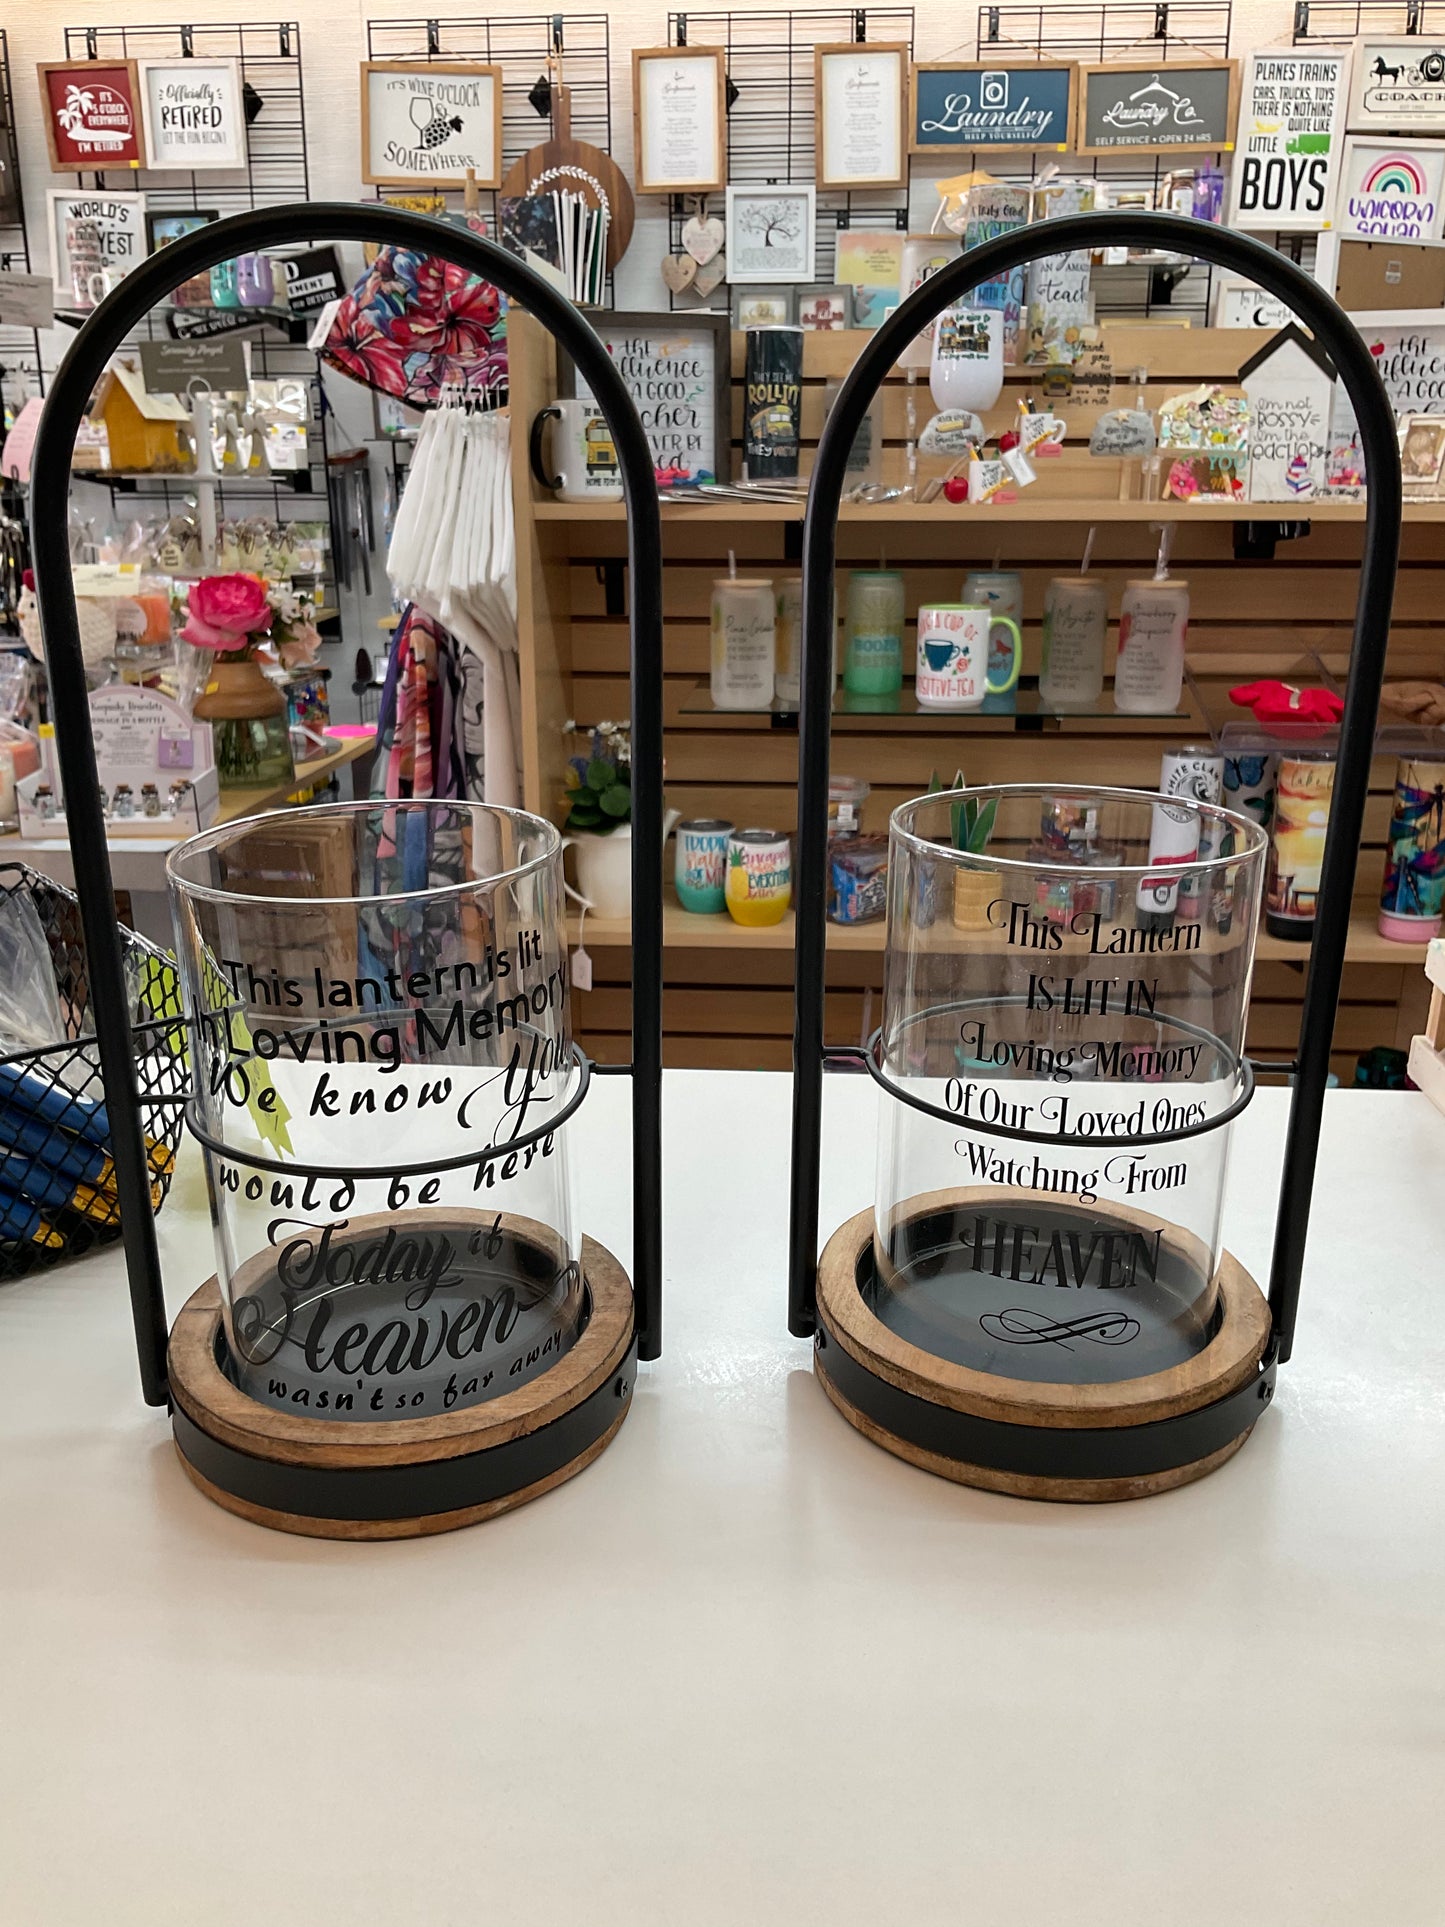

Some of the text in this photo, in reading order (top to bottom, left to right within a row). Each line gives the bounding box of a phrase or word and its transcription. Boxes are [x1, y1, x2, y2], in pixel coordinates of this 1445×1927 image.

[1255, 62, 1338, 82] PLANES TRAINS
[165, 83, 215, 106] Officially
[386, 78, 480, 107] IT'S WINE O'CLOCK
[1252, 86, 1276, 101] CARS,
[1314, 87, 1335, 101] TOYS
[921, 93, 1054, 138] Laundry
[1102, 100, 1170, 128] Laundry
[1252, 101, 1334, 118] THERE IS NOTHING
[964, 133, 987, 141] HELP
[1288, 118, 1331, 132] QUITE LIKE
[1095, 134, 1212, 146] SELF SERVICE OPEN 24 HRS
[1248, 136, 1278, 153] LITTLE
[1239, 157, 1328, 212] BOYS
[69, 202, 130, 223] WORLD'S
[1349, 198, 1434, 223] UNICORN
[98, 232, 134, 255] YEST
[289, 279, 323, 295] EMENT
[620, 356, 705, 383] fluence
[1416, 380, 1445, 399] GOO
[641, 402, 701, 429] cher
[986, 898, 1202, 955] This Lantern
[222, 928, 543, 1008] This lantern is lit
[1025, 973, 1159, 1016] IS LIT IN
[223, 1007, 400, 1074] Loving
[414, 961, 567, 1055] Memory
[960, 1020, 1204, 1084] Loving Memory
[210, 1025, 567, 1149] We know You
[945, 1077, 1207, 1137] Of Our Loved Ones
[219, 1131, 555, 1214] would be here
[954, 1139, 1188, 1204] Watching From
[266, 1217, 464, 1312] Today
[958, 1214, 1166, 1290] HEAVEN
[232, 1260, 582, 1376] Heaven
[267, 1328, 563, 1412] wasn't so far away
